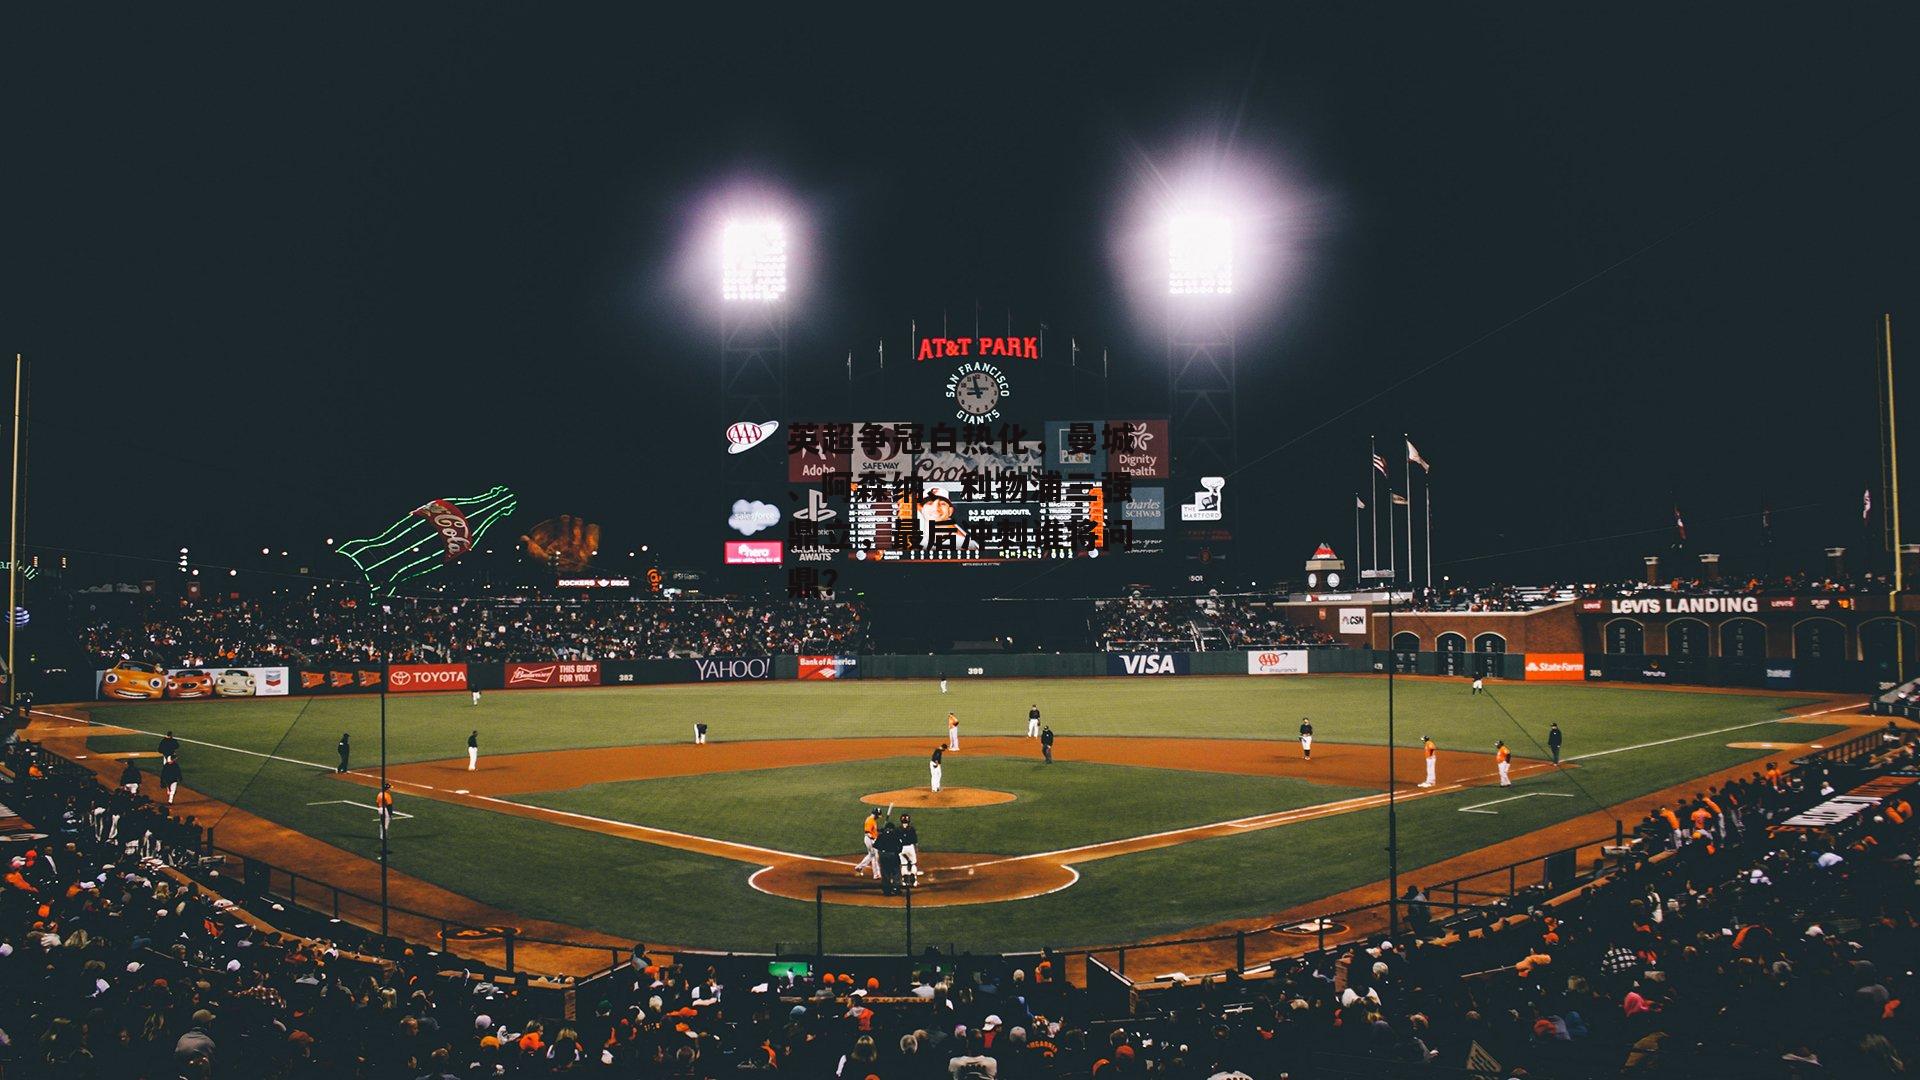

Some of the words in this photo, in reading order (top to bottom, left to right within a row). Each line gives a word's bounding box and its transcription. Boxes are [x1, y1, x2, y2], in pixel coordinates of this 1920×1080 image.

[917, 337, 972, 360] AT&T
[979, 336, 1038, 359] PARK
[945, 373, 960, 398] SAN
[958, 361, 1010, 397] FRANCISCO
[956, 409, 1001, 425] GIANTS
[862, 462, 900, 470] SAFEWAY
[1119, 454, 1157, 467] Dignity
[1125, 498, 1160, 510] charles
[1125, 510, 1161, 518] SCHWAB
[434, 514, 471, 555] Cola
[799, 553, 832, 561] AWAITS
[1666, 597, 1758, 613] LANDING
[1350, 616, 1364, 625] CSN
[800, 657, 818, 665] Bank
[819, 657, 826, 665] of
[826, 656, 856, 666] America
[1119, 654, 1175, 674] VISA
[560, 664, 575, 673] THIS
[577, 664, 598, 673] BUD'S
[696, 658, 770, 680] YAHOO!
[413, 671, 467, 683] TOYOTA
[560, 674, 574, 682] FOR
[575, 674, 590, 682] YOU.
